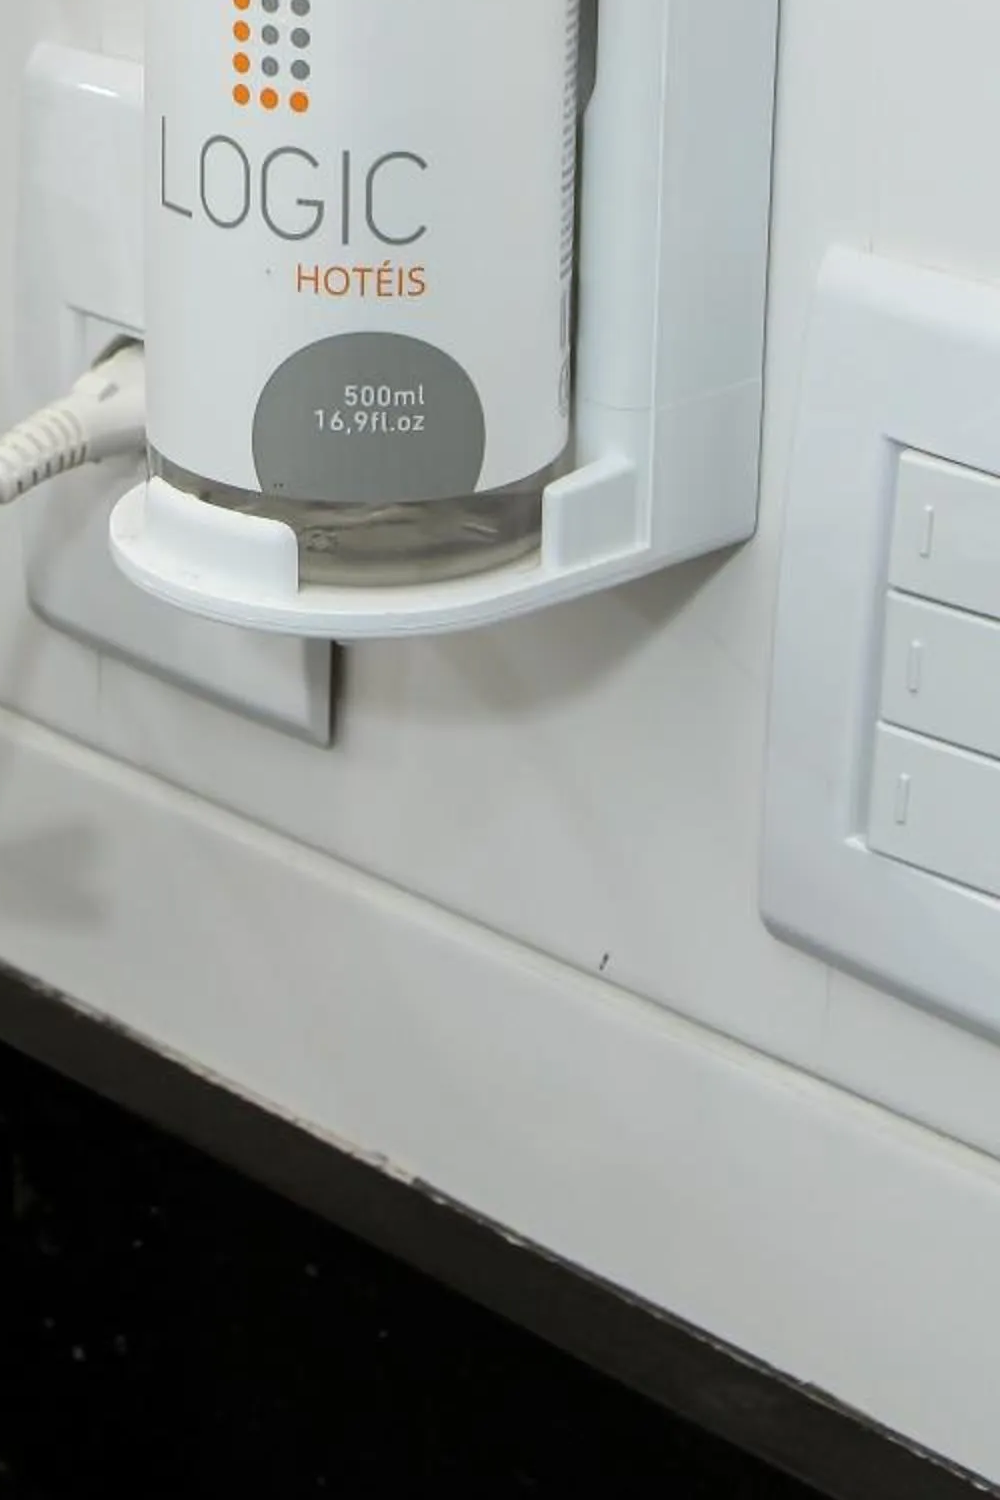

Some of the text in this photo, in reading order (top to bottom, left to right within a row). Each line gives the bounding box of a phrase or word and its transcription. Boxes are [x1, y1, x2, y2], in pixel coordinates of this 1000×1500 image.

[161, 115, 428, 245] LOGIC
[296, 259, 427, 298] HOTÉIS
[344, 383, 425, 408] 500ml
[313, 408, 426, 435] 16,9fl.oz
